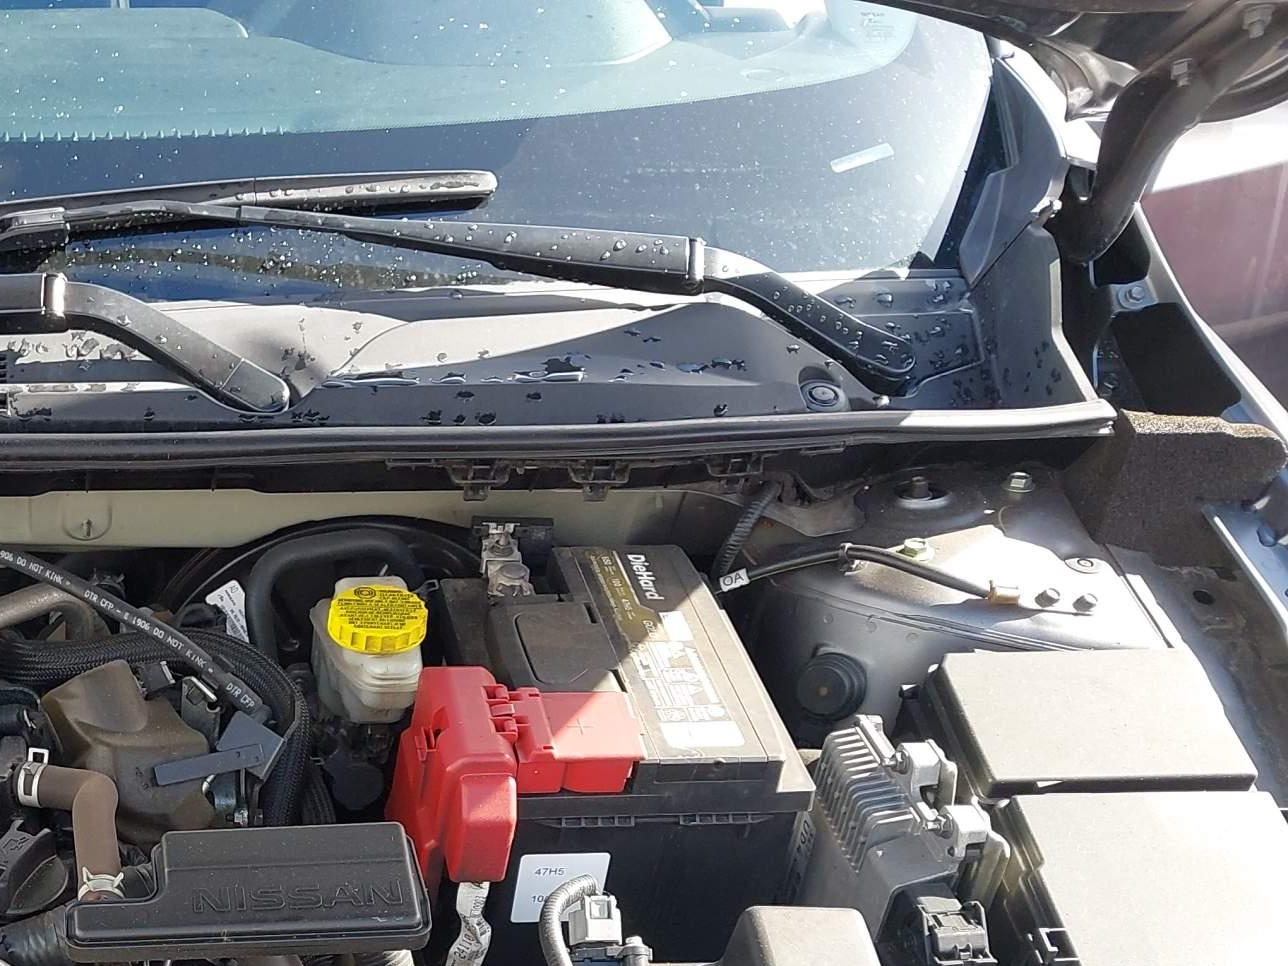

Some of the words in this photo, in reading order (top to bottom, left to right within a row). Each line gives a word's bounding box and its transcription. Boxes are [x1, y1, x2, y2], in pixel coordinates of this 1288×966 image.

[16, 556, 27, 567] DO
[29, 561, 44, 574] NOT
[45, 569, 64, 584] KINK
[626, 553, 665, 600] DieHard
[132, 616, 150, 631] 1906
[152, 628, 165, 639] DO
[166, 636, 184, 650] NOT
[185, 648, 208, 669] KINK
[240, 694, 256, 709] CFP
[534, 867, 565, 876] 47H5
[192, 880, 403, 912] NISSAN
